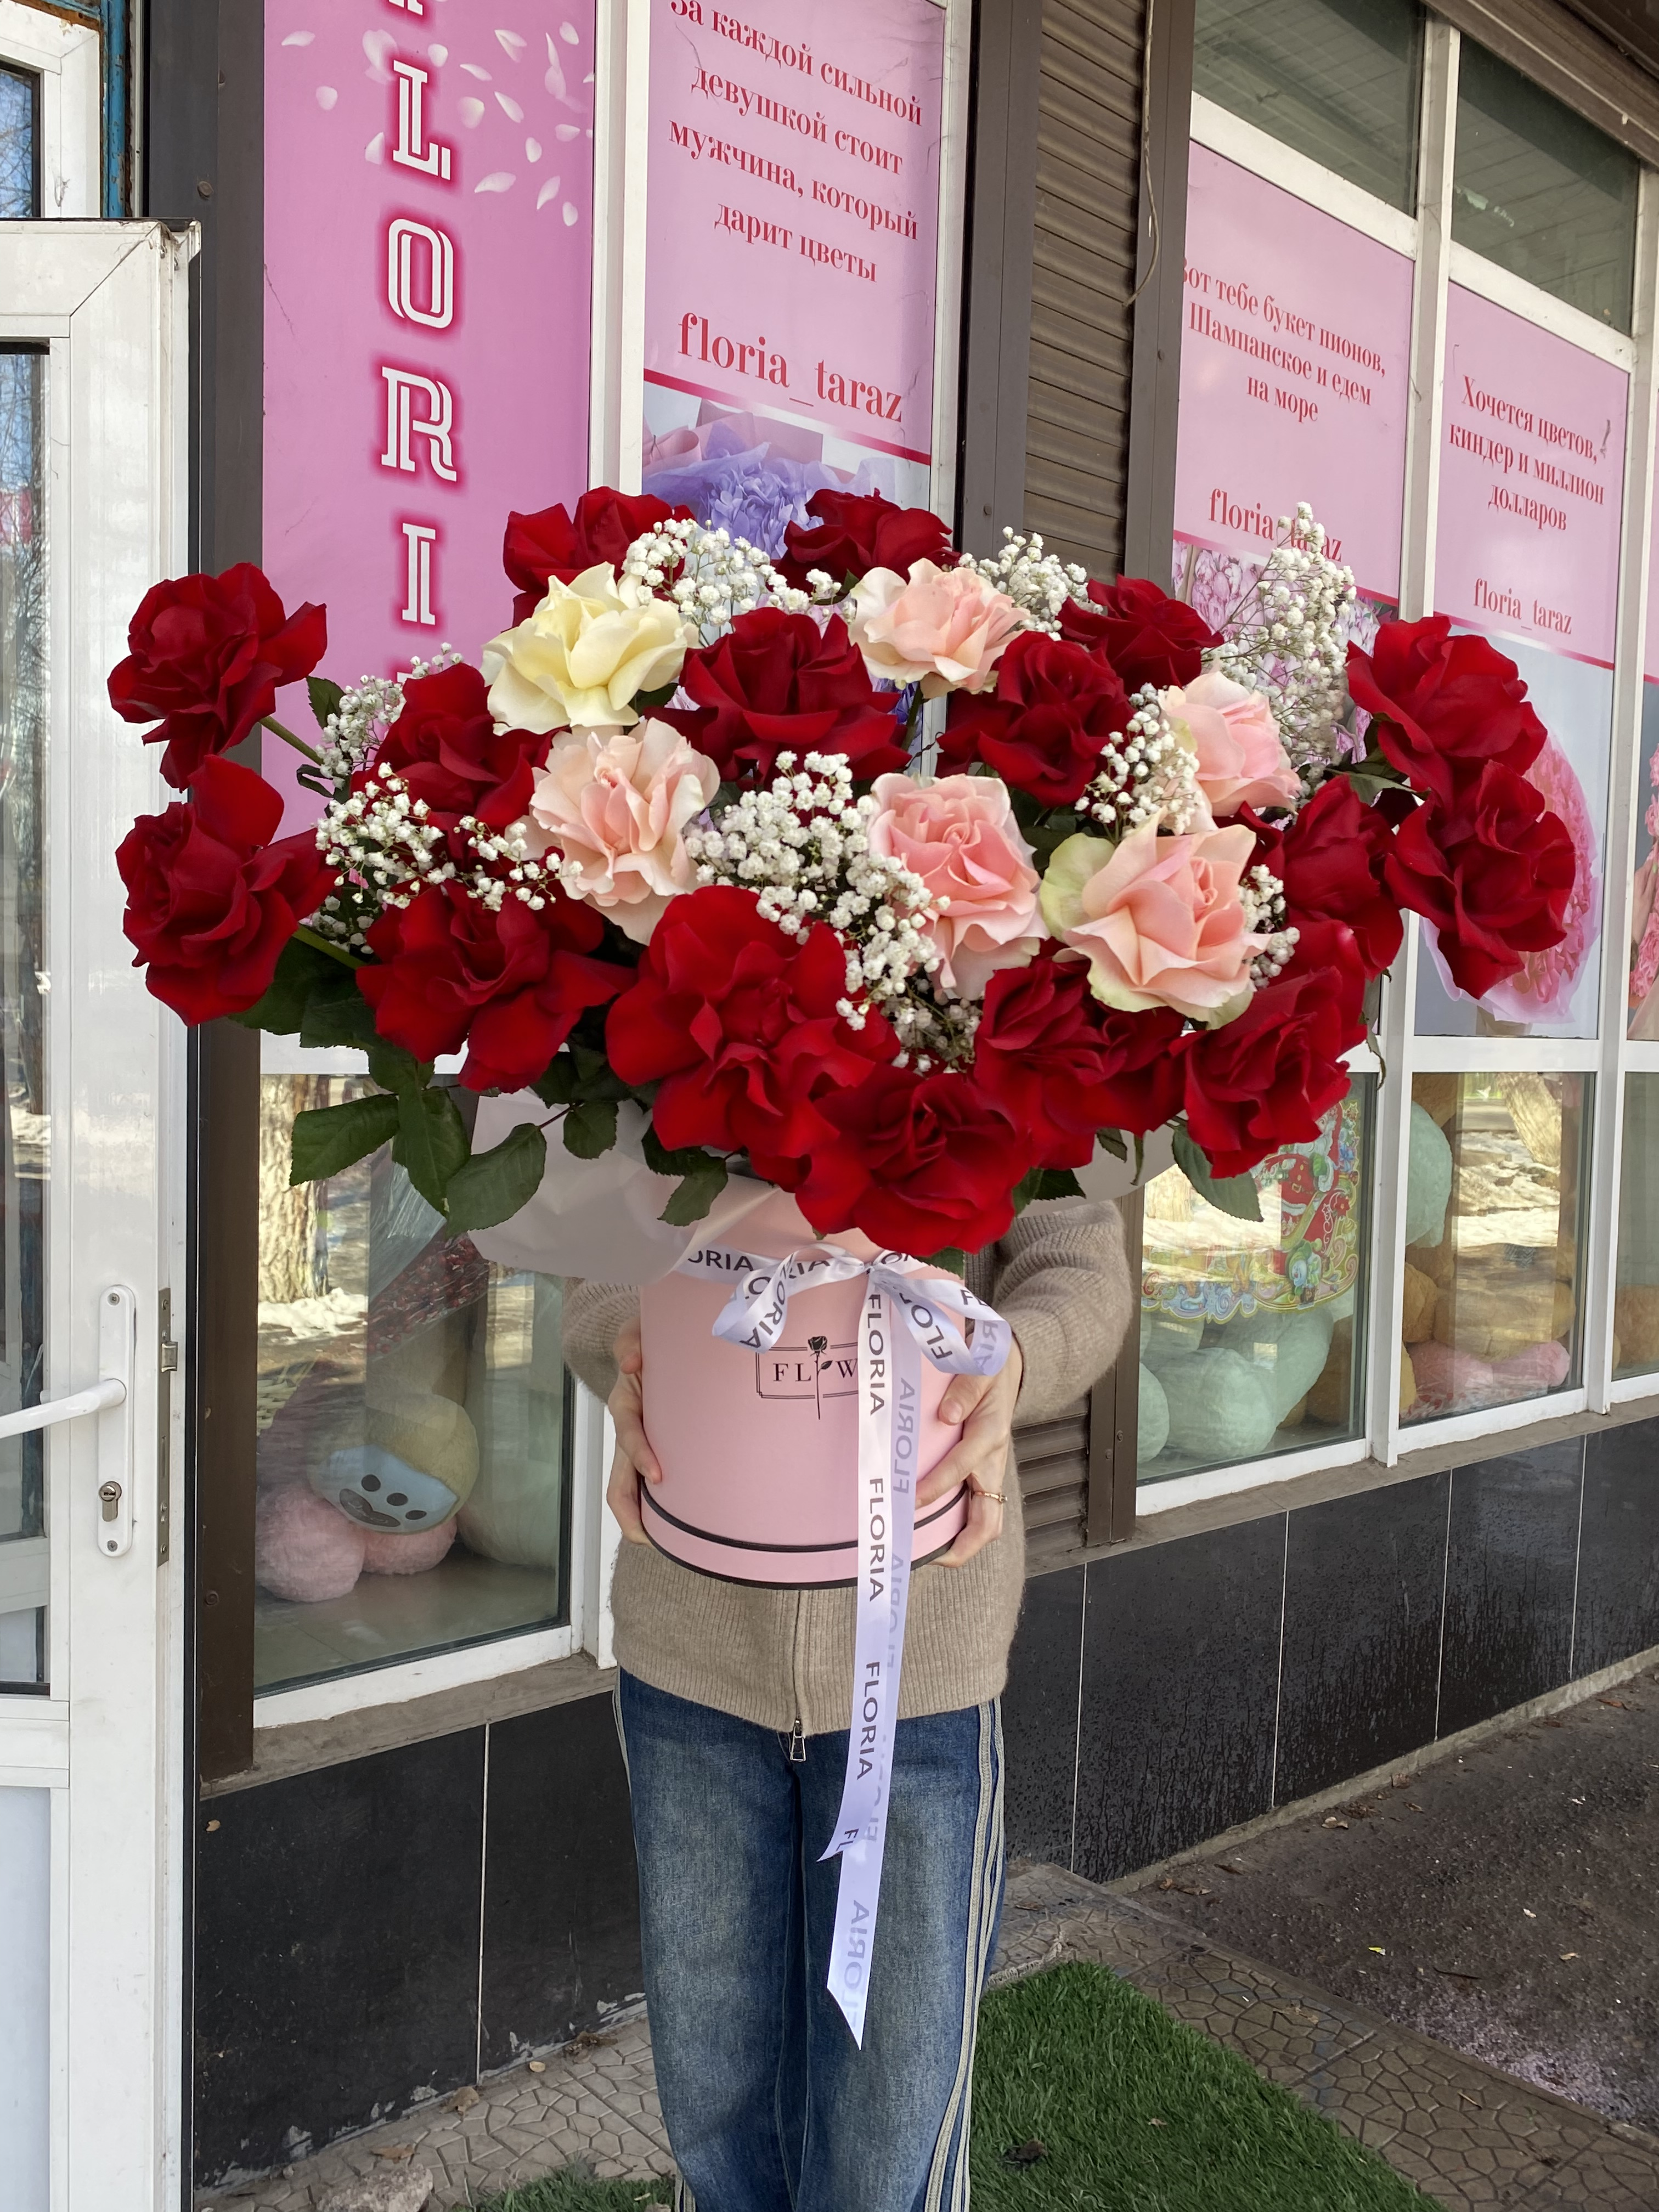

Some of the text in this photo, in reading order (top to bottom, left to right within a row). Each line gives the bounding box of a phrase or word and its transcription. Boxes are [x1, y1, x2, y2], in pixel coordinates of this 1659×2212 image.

[691, 66, 902, 175] девушкой стоит
[712, 9, 814, 76] каждой
[821, 63, 923, 127] сильной
[669, 120, 918, 241] мужчина, который
[714, 204, 877, 283] дарит цветы
[381, 0, 457, 684] LORI
[678, 312, 901, 423] floria_taraz
[1188, 301, 1371, 405] Шампанское и едем
[1216, 279, 1259, 315] тебе
[1263, 295, 1315, 341] букет
[1319, 328, 1385, 377] пионов,
[1247, 376, 1318, 423] на море
[1462, 375, 1598, 464] Хочется цветов,
[1448, 424, 1605, 505] киндер и миллион
[1488, 484, 1567, 531] долларов
[1474, 578, 1572, 635] floria_taraz
[868, 1294, 885, 1416] FLORIA
[869, 1478, 885, 1602] FLORIA
[857, 1661, 880, 1780] FLORIA
